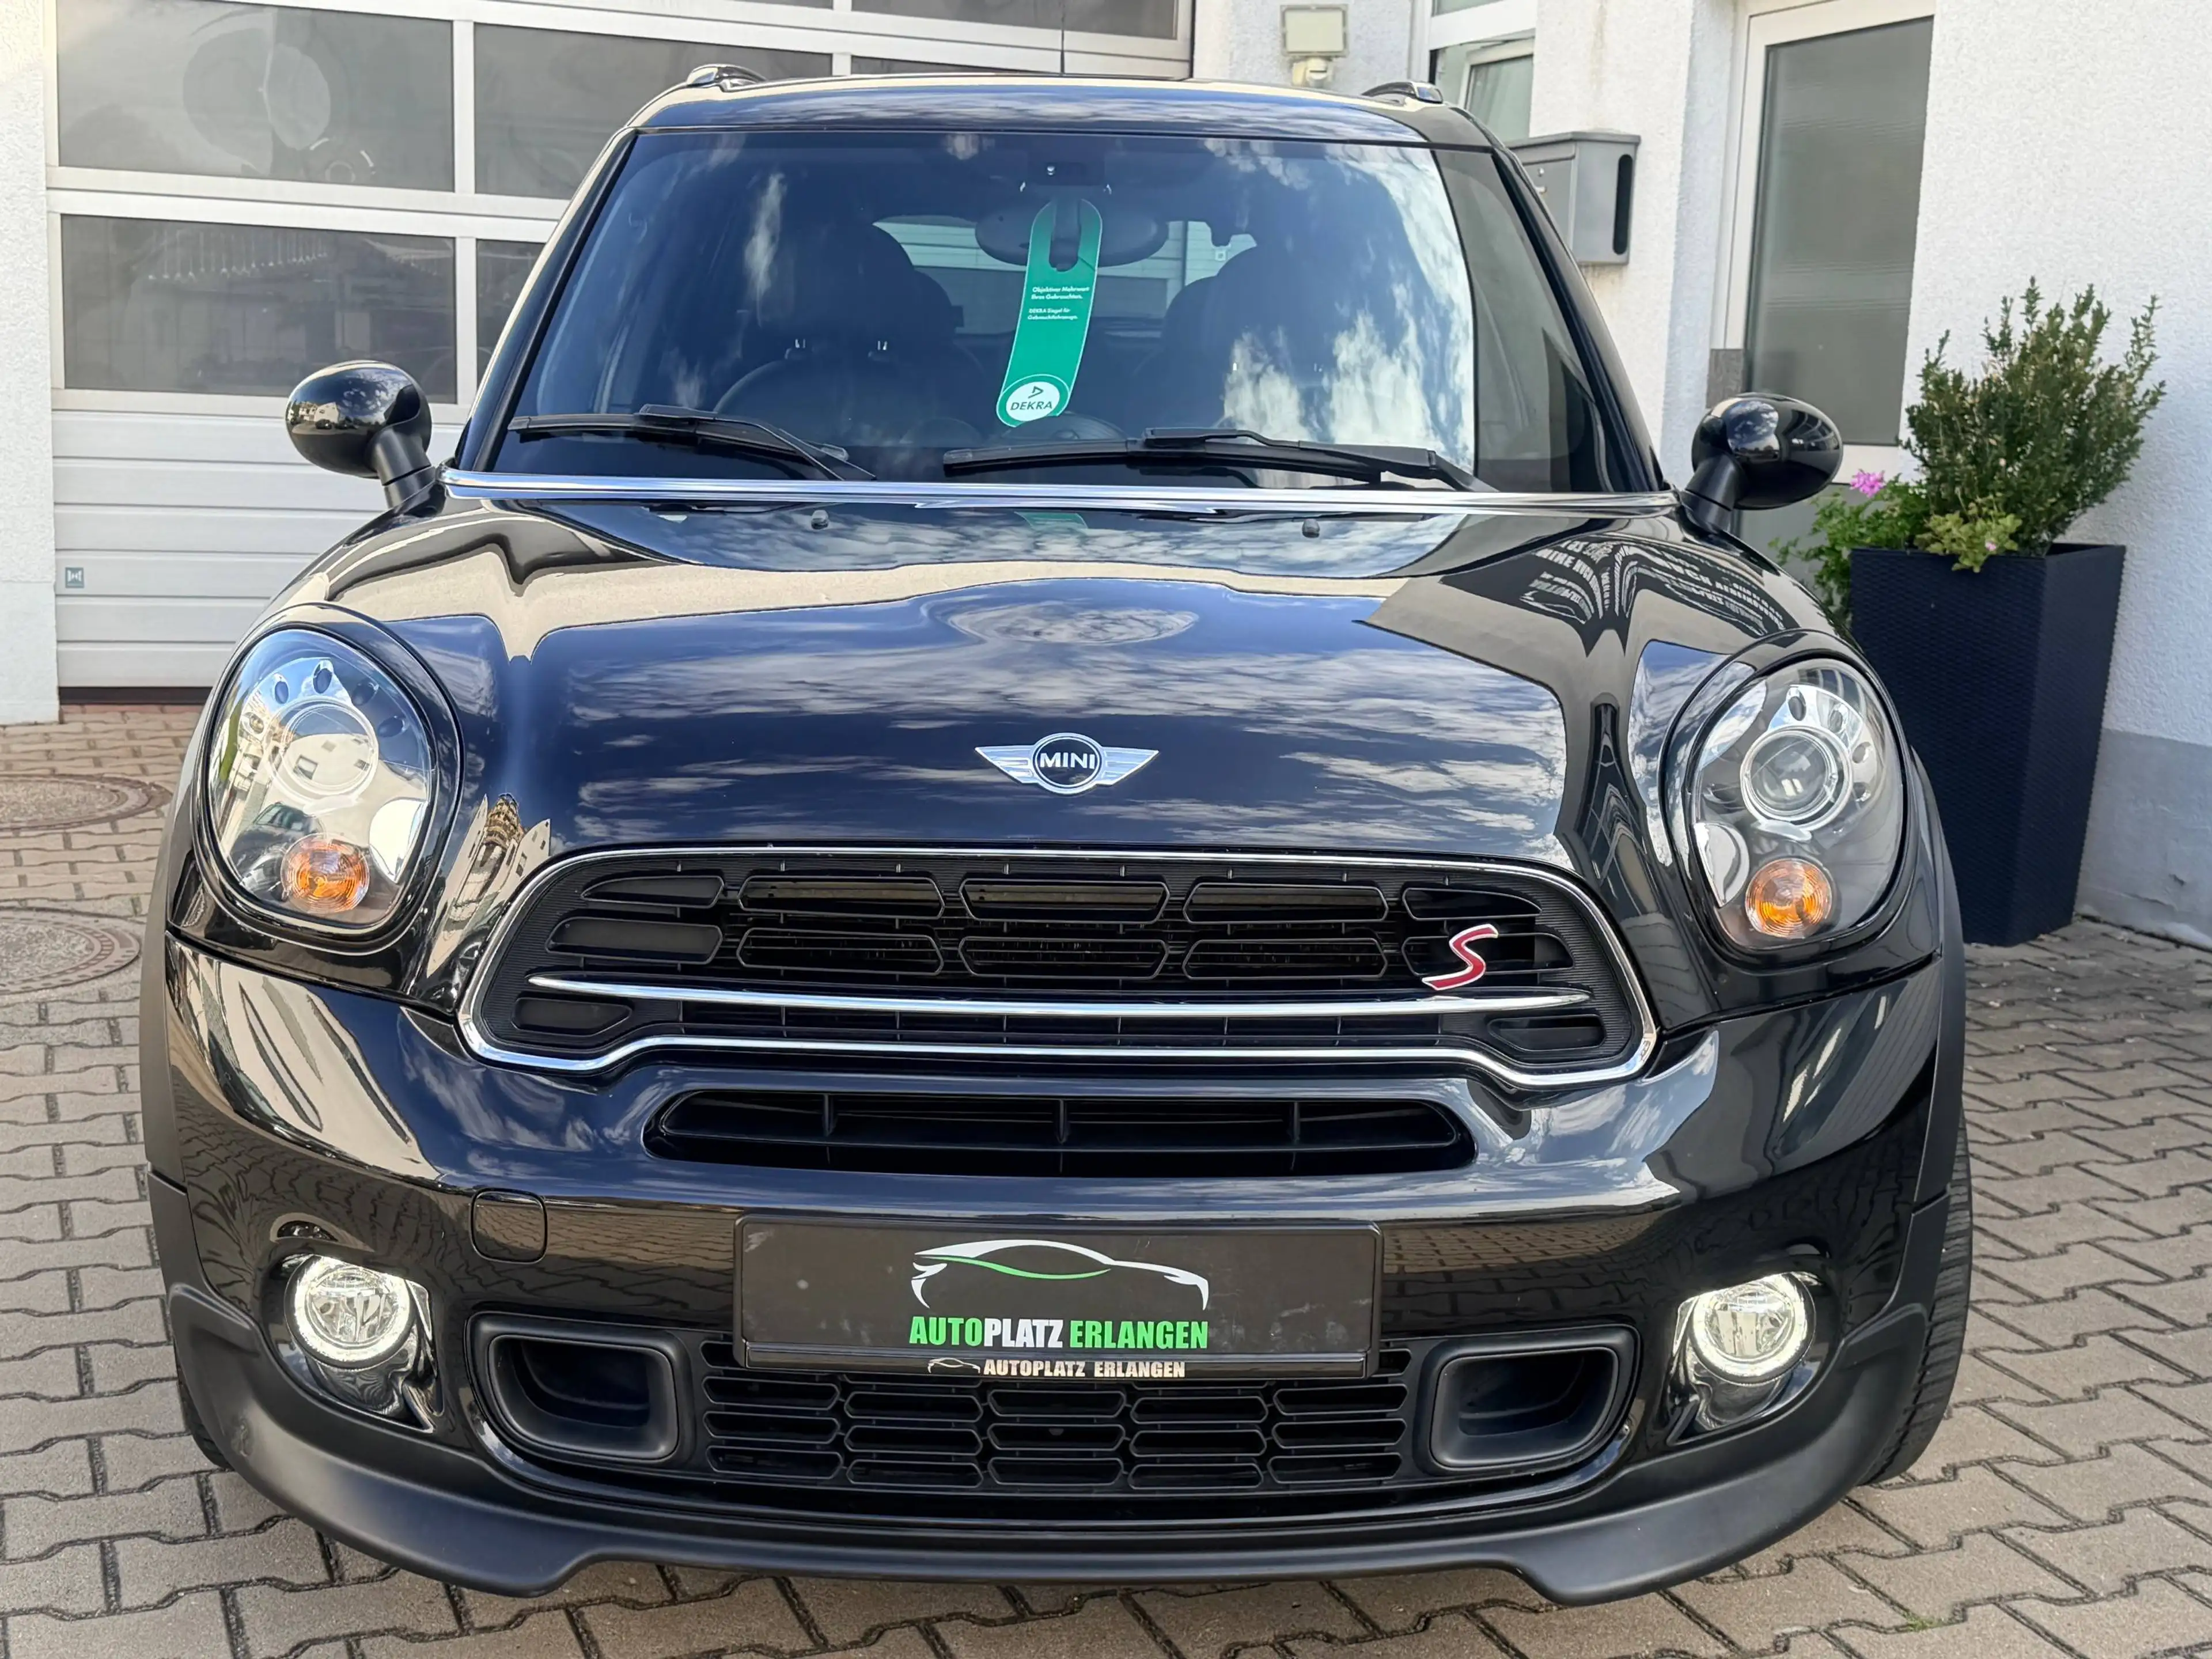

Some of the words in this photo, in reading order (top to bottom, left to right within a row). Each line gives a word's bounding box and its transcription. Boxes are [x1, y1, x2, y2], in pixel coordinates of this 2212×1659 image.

[1010, 401, 1052, 410] DEKRA
[1040, 752, 1094, 769] MINI
[1422, 923, 1498, 991] S
[909, 1316, 1064, 1349] AUTOPLATZ
[1070, 1320, 1209, 1349] ERLANGEN
[983, 1359, 1086, 1377] AUTOPLATZ
[1094, 1361, 1185, 1378] ERLANGEN
